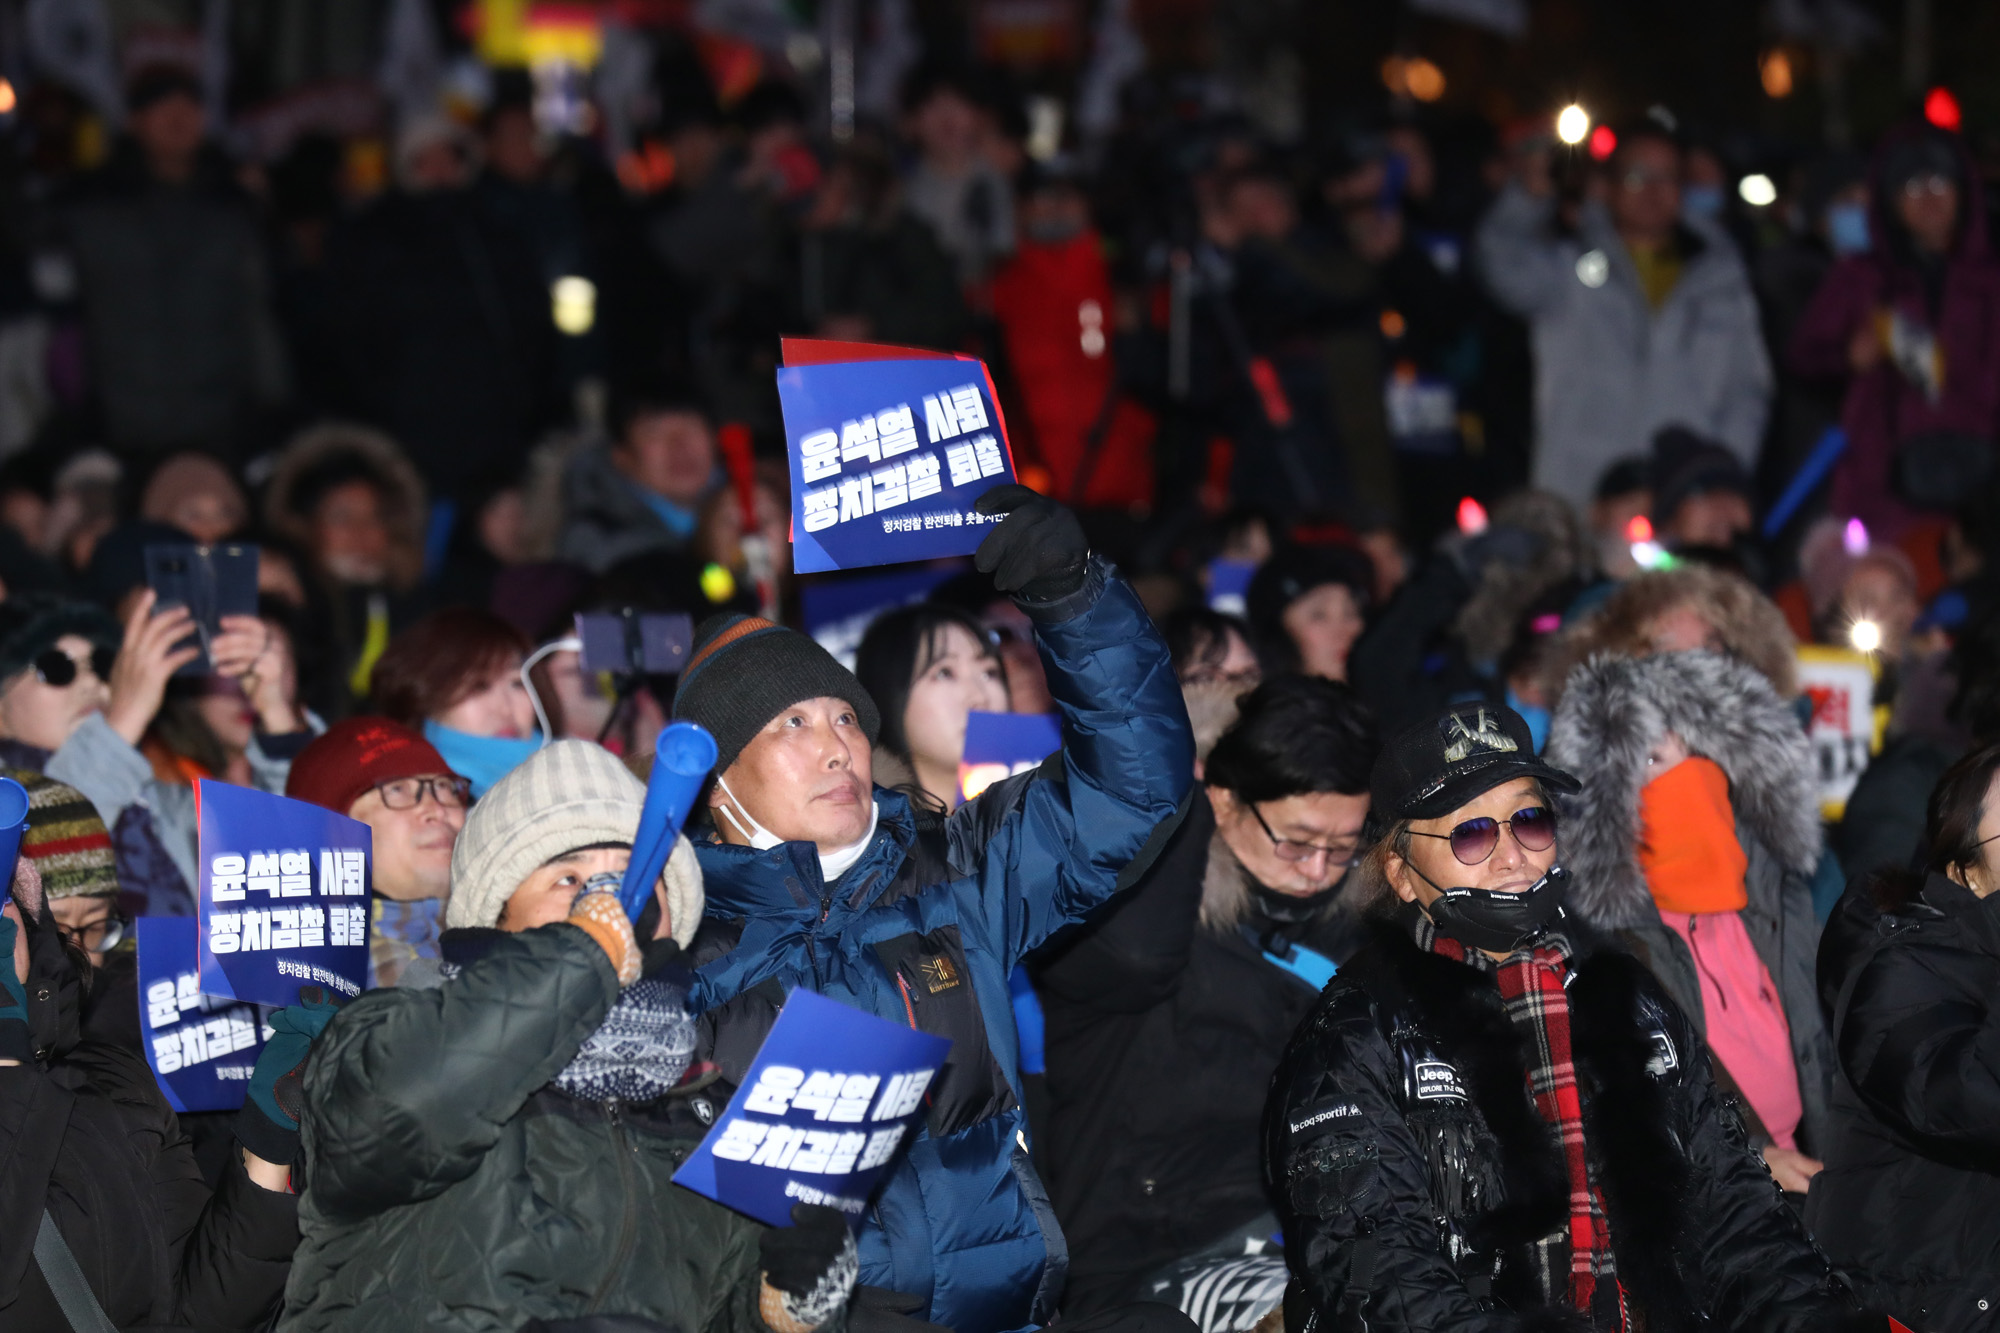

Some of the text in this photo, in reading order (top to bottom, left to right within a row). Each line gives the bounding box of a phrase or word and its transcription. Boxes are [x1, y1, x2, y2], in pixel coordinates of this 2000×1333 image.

[801, 384, 989, 484] 윤석열 사퇴
[801, 435, 1005, 533] 정치검찰 퇴출
[883, 518, 922, 533] 정치검찰
[924, 513, 963, 529] 완전퇴출
[211, 851, 365, 902] 윤석열 사퇴
[208, 905, 366, 954] 정치검찰 퇴출
[277, 961, 311, 979] 정치검찰
[151, 1009, 257, 1075] 정치검찰
[743, 1065, 935, 1123] 윤석열 사퇴
[1420, 1068, 1454, 1083] Jeep
[711, 1118, 867, 1175] 정치검찰
